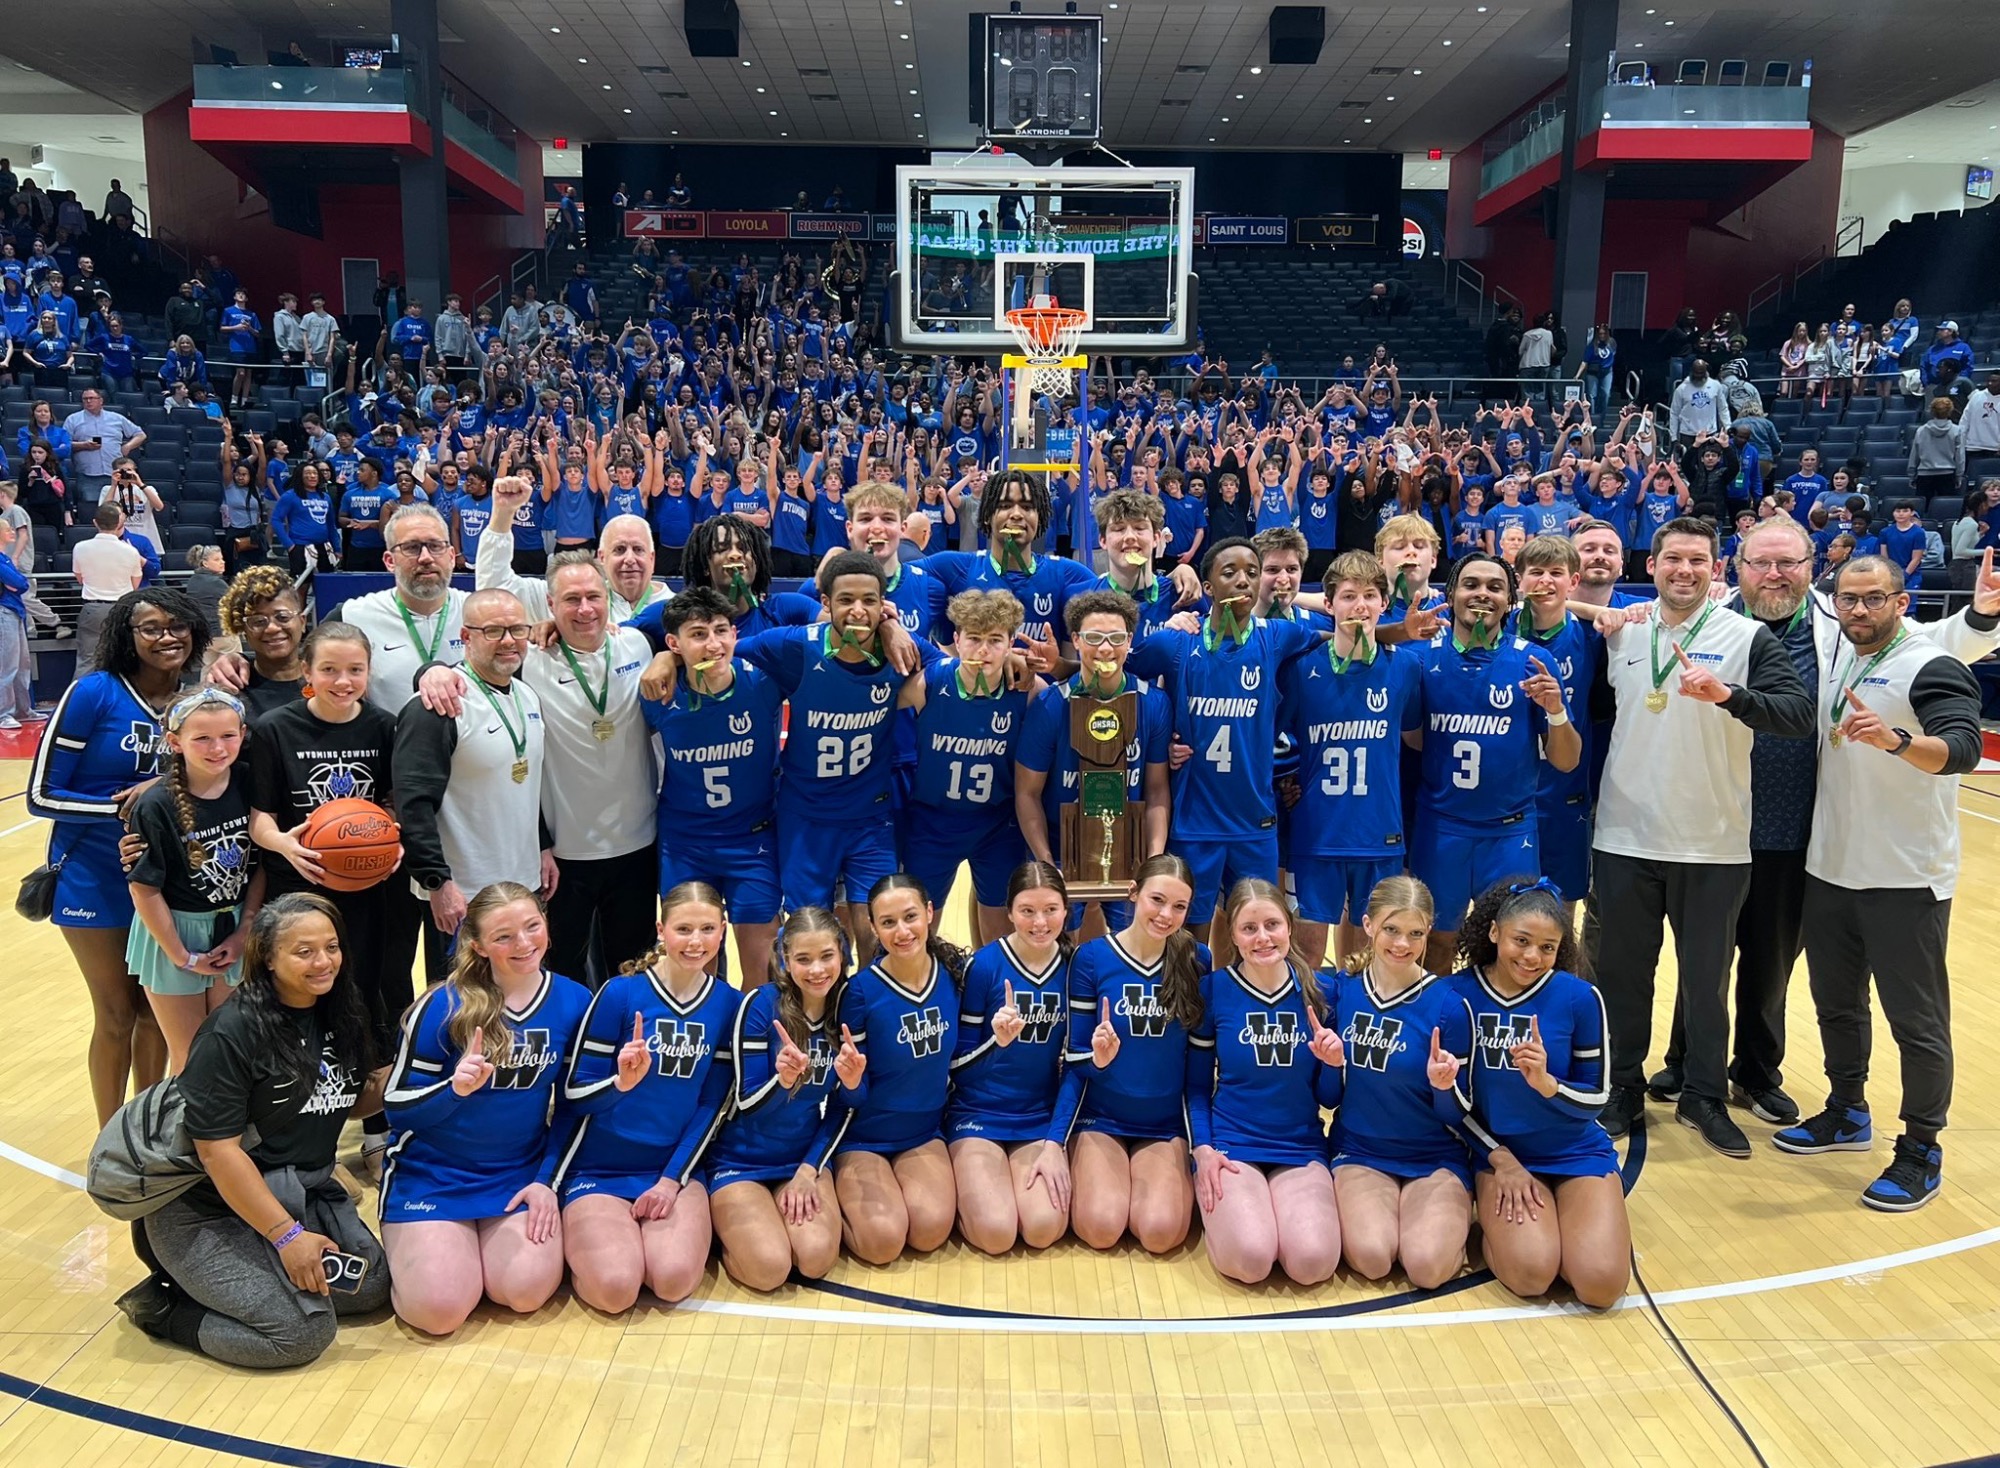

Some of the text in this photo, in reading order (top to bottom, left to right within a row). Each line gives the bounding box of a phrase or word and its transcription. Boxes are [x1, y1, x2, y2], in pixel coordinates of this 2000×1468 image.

[725, 219, 768, 231] LOYOLA
[797, 220, 862, 232] RICHMOND
[1211, 225, 1245, 236] SAINT
[1250, 225, 1284, 236] LOUIS
[1322, 225, 1352, 236] VCU
[460, 509, 490, 519] COWBOYS
[808, 707, 888, 730] WYOMING
[1187, 697, 1258, 718] WYOMING
[1092, 720, 1116, 729] OHSAA
[1309, 720, 1388, 744] WYOMING
[1430, 713, 1512, 735] WYOMING
[297, 751, 338, 759] WYOMING
[670, 738, 754, 763] WYOMING
[817, 733, 873, 778] 22
[932, 733, 1007, 756] WYOMING
[1206, 725, 1232, 773] 4
[1321, 747, 1368, 796] 31
[1452, 740, 1480, 790] 3
[703, 766, 732, 808] 5
[946, 760, 994, 803] 13
[181, 826, 220, 843] WOMING
[62, 907, 97, 920] Cowboys
[897, 1018, 949, 1044] Cowboys
[901, 1006, 943, 1058] W
[1238, 1025, 1307, 1048] Cowboys
[1246, 1011, 1298, 1067] W
[1342, 1025, 1407, 1055] Cowboys
[1352, 1011, 1403, 1073] W
[645, 1033, 710, 1060] Cowboys
[656, 1018, 704, 1078] W
[404, 1201, 437, 1211] Cowboys
